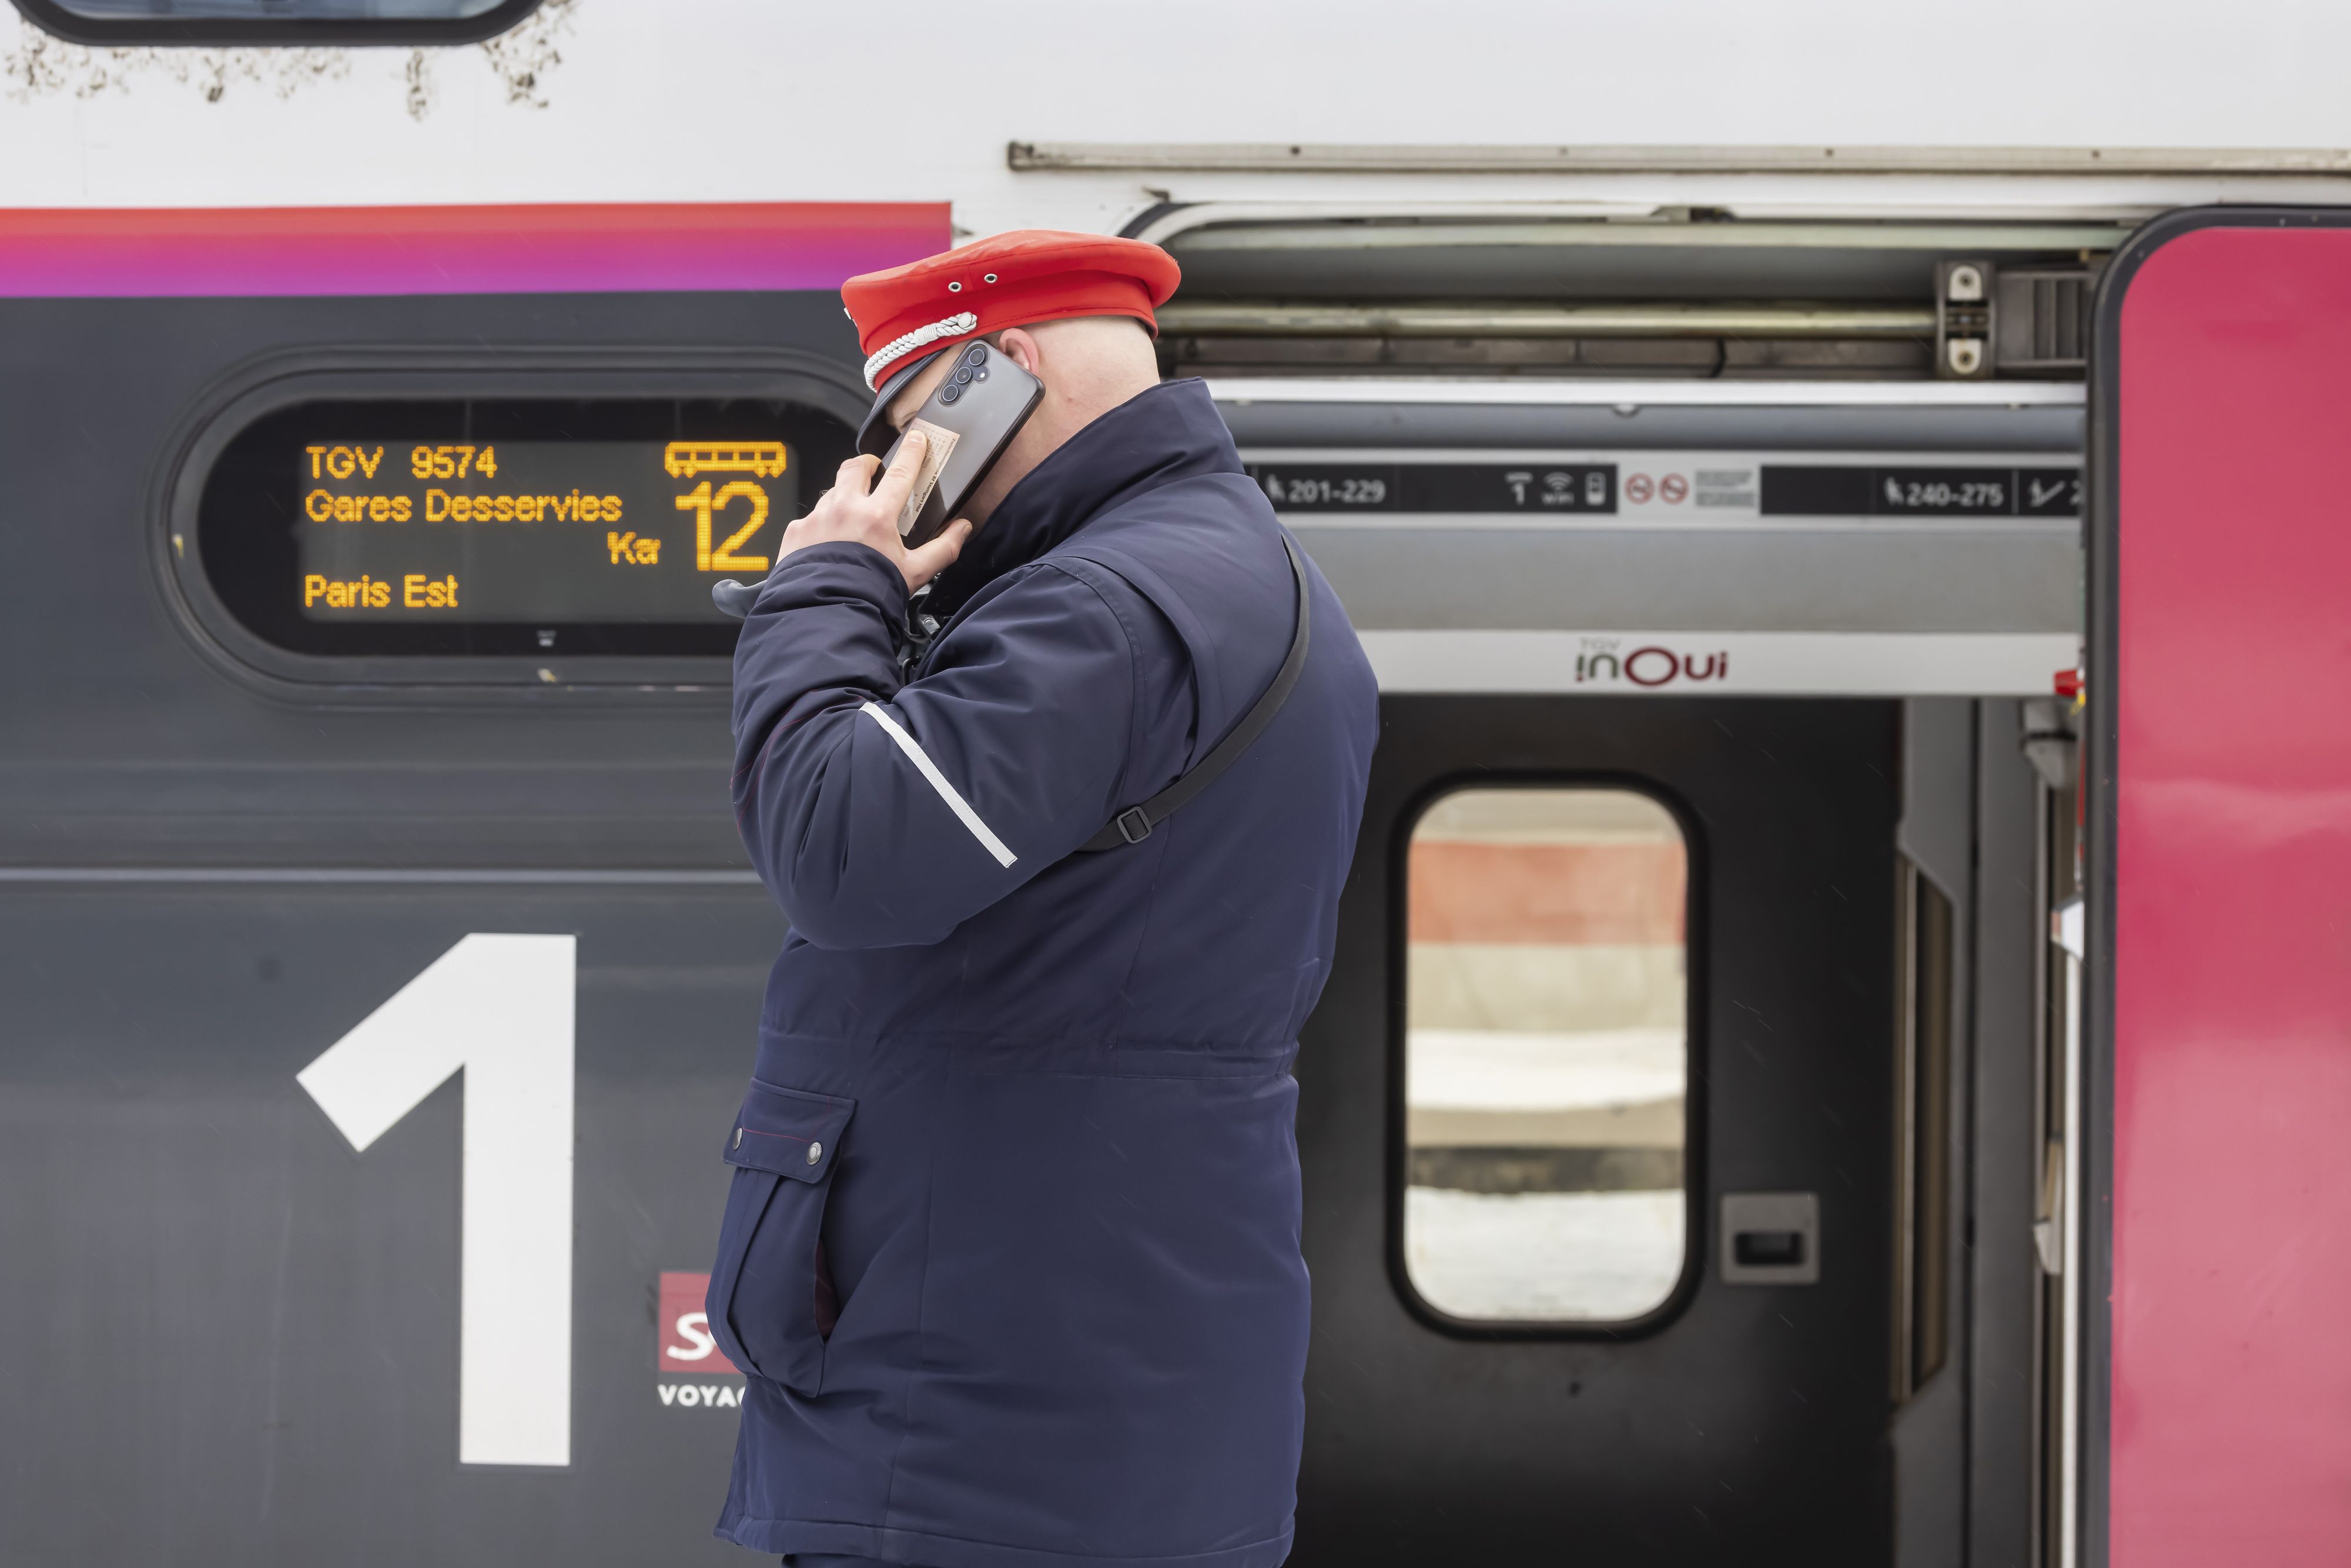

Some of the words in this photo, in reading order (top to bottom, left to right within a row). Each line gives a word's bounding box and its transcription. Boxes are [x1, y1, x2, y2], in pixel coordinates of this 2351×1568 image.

[306, 447, 383, 479] TGV
[411, 446, 497, 478] 9574
[306, 489, 412, 522] Gares
[426, 489, 622, 522] Desservies
[919, 481, 933, 502] Stuttgart
[1289, 480, 1386, 502] 201-229
[1907, 483, 2004, 507] 240-275
[675, 481, 769, 571] 12
[305, 575, 391, 608] Paris
[404, 574, 458, 608] Est
[296, 933, 576, 1466] 1
